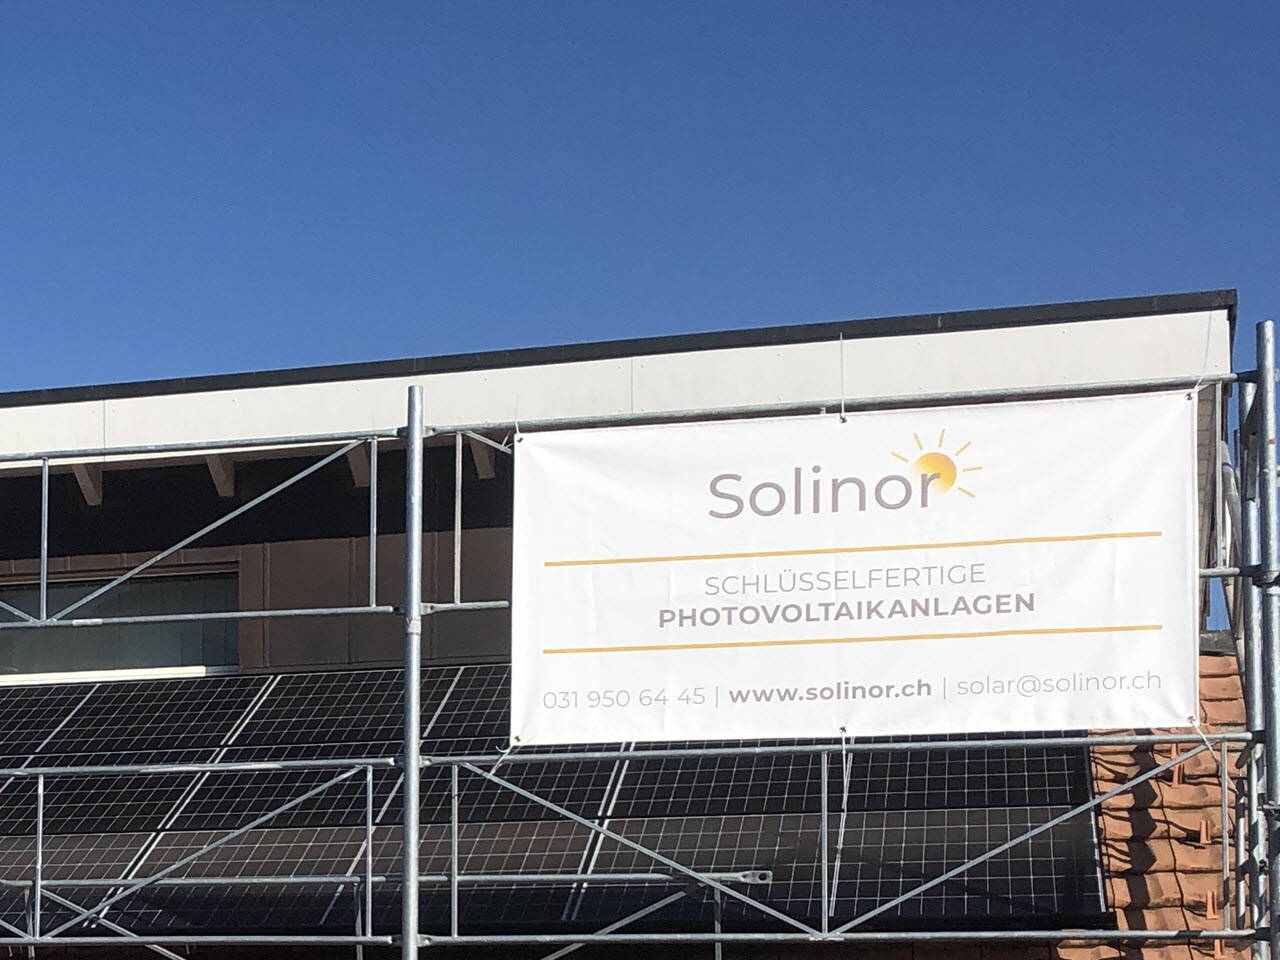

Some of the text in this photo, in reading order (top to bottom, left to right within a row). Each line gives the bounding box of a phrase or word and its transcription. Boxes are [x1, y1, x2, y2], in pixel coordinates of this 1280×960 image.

[709, 465, 940, 519] Solinor
[705, 563, 986, 597] SCHLÜSSELFERTIGE
[659, 592, 1035, 629] PHOTOVOLTAIKANLAGEN
[543, 670, 1162, 709] 031 950 64 45 www.solinor.ch solar@solinor.ch
